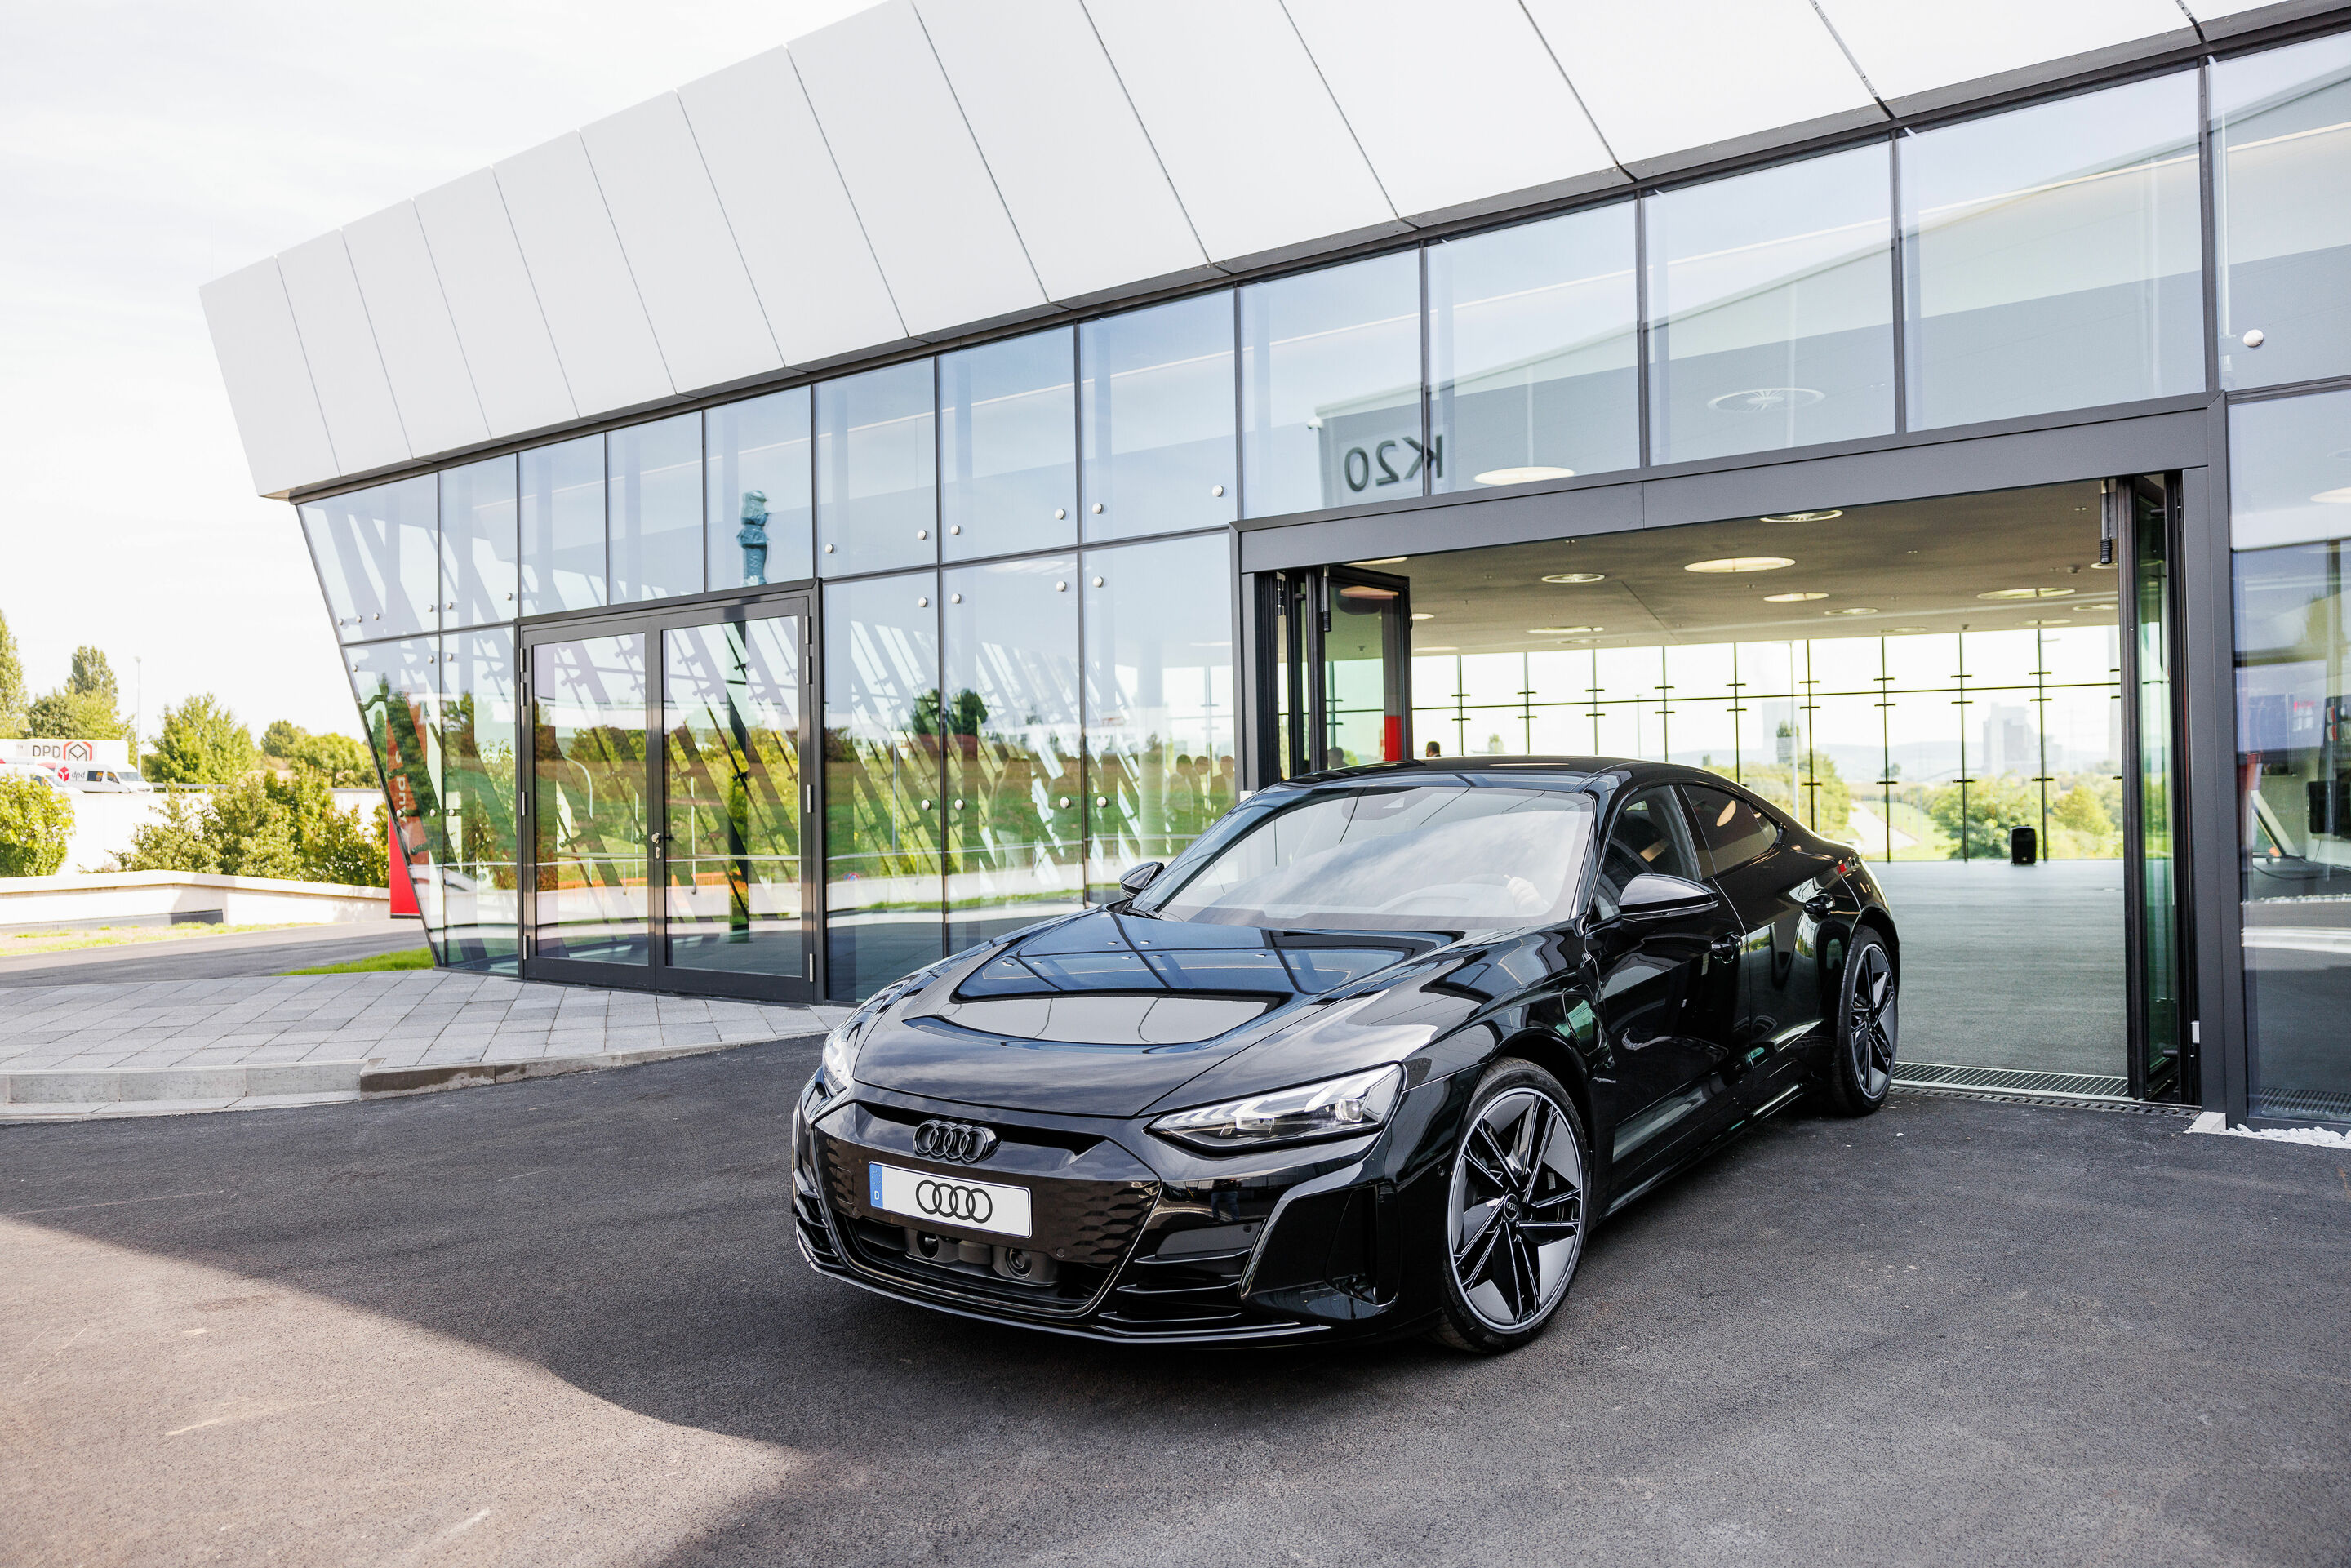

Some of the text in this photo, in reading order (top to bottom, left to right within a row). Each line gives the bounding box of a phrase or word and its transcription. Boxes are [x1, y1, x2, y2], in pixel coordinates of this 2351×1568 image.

[33, 745, 61, 758] DPD
[71, 771, 86, 781] dpd
[874, 1190, 880, 1200] D
